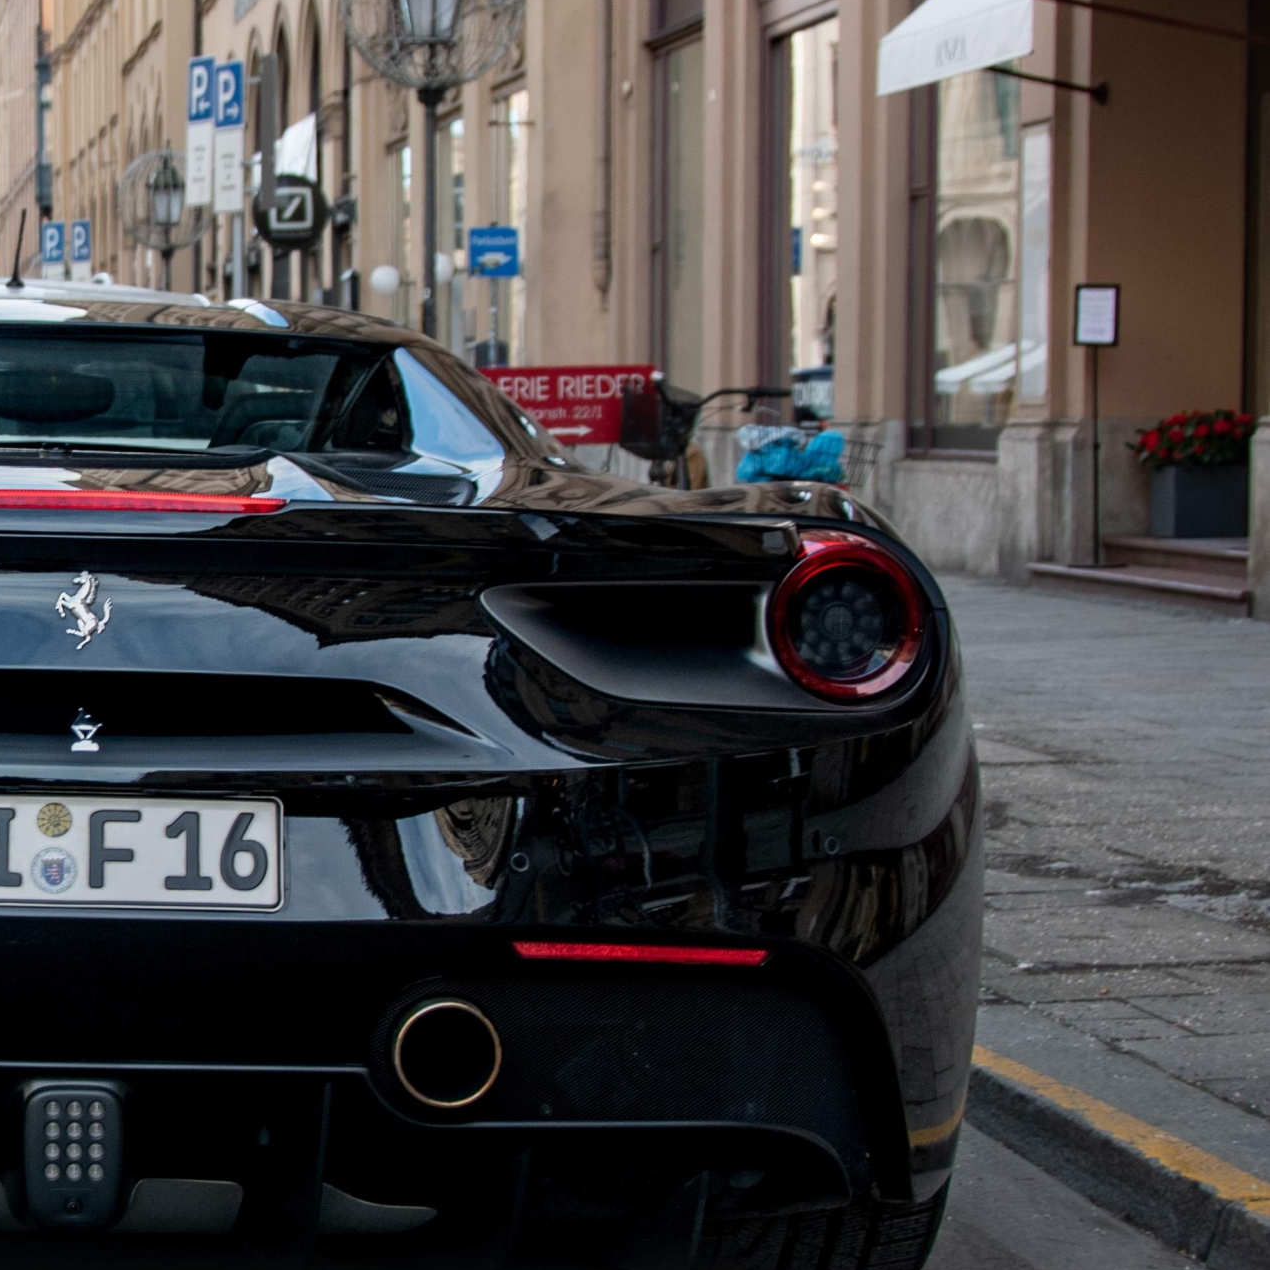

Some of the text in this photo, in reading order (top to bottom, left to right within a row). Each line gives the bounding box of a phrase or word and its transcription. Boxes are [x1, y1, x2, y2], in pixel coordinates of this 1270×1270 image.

[191, 65, 209, 117] P
[218, 70, 236, 122] P
[489, 373, 645, 400] ERIE RIEDER
